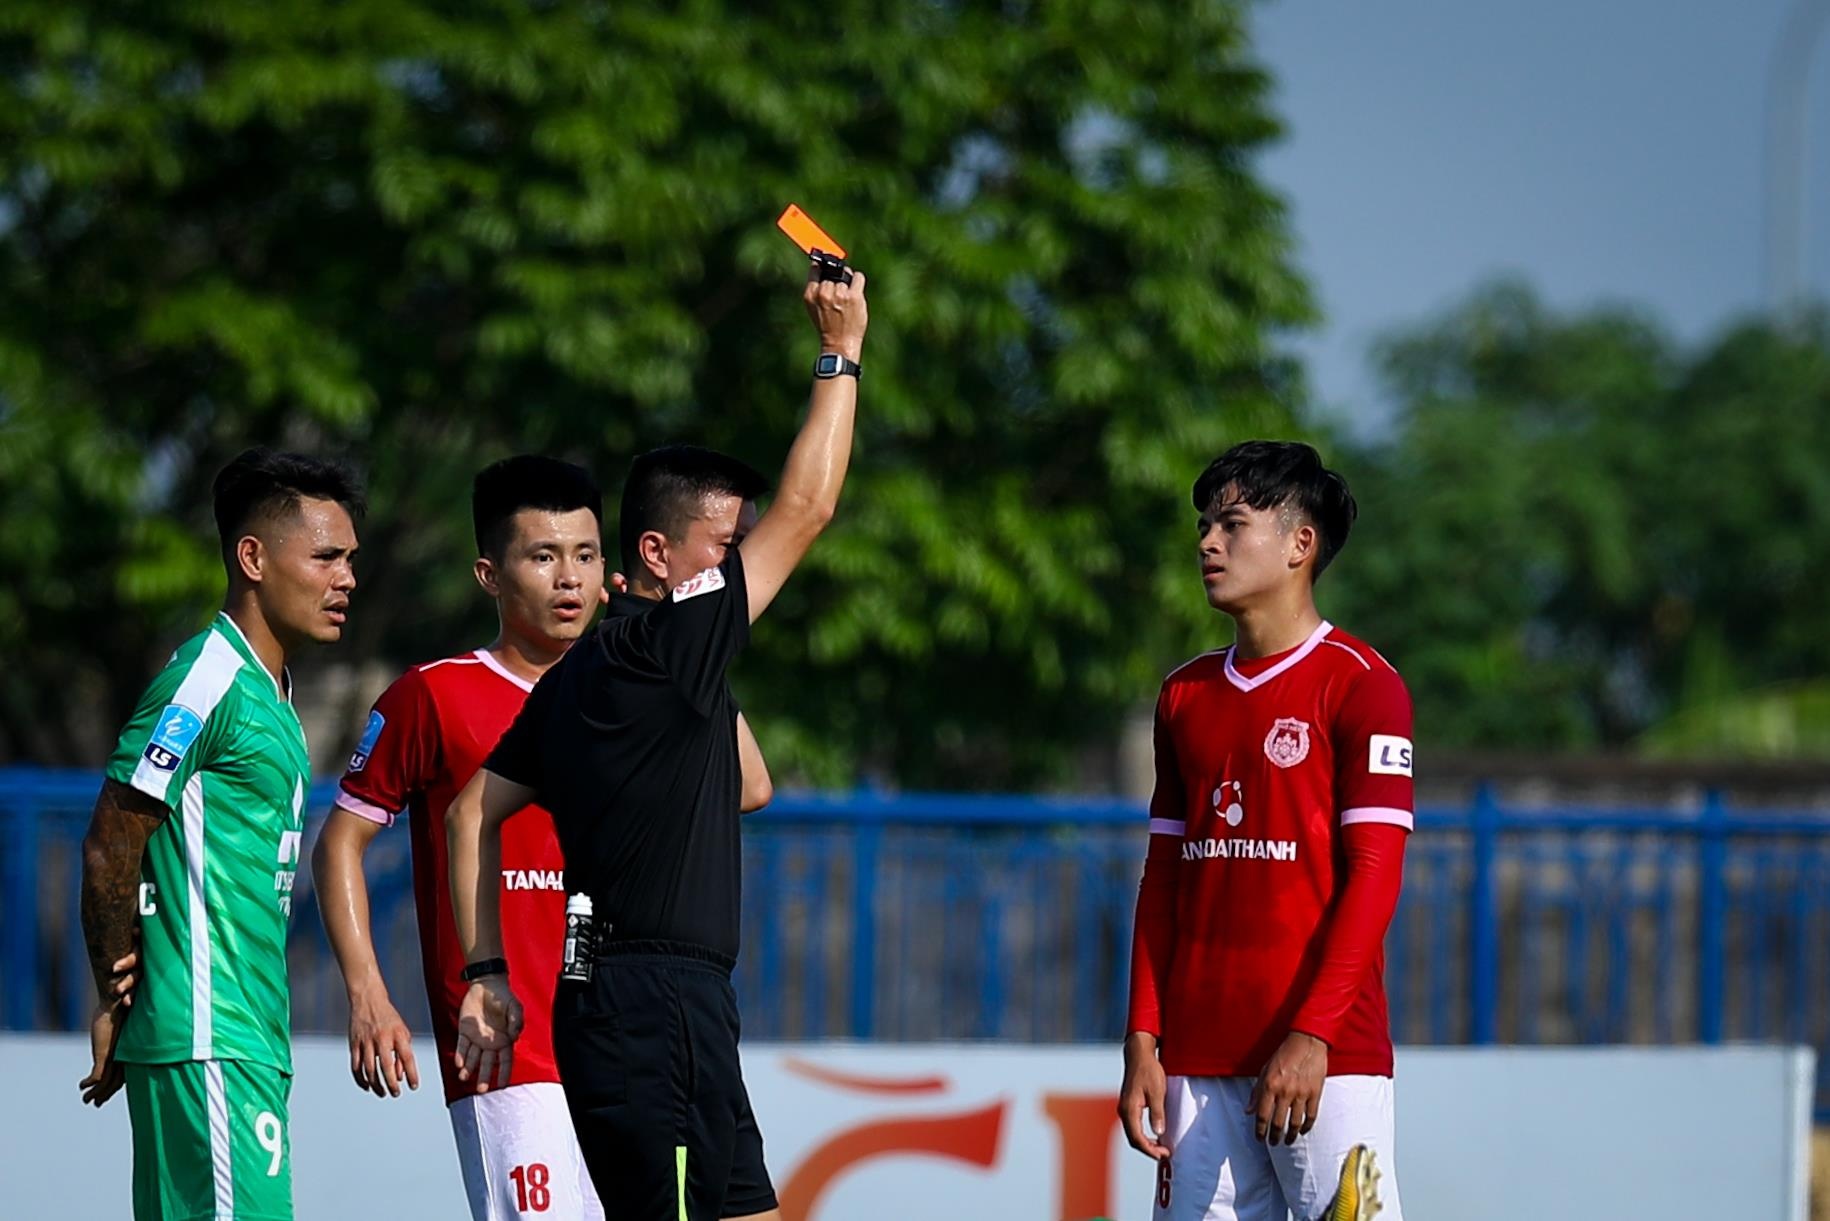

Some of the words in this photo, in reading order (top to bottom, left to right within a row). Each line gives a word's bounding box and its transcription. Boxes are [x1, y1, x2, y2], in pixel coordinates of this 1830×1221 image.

[149, 747, 172, 767] LS
[349, 753, 364, 768] LS
[1380, 745, 1411, 769] LS
[255, 1110, 282, 1177] 9
[510, 1162, 551, 1213] 18
